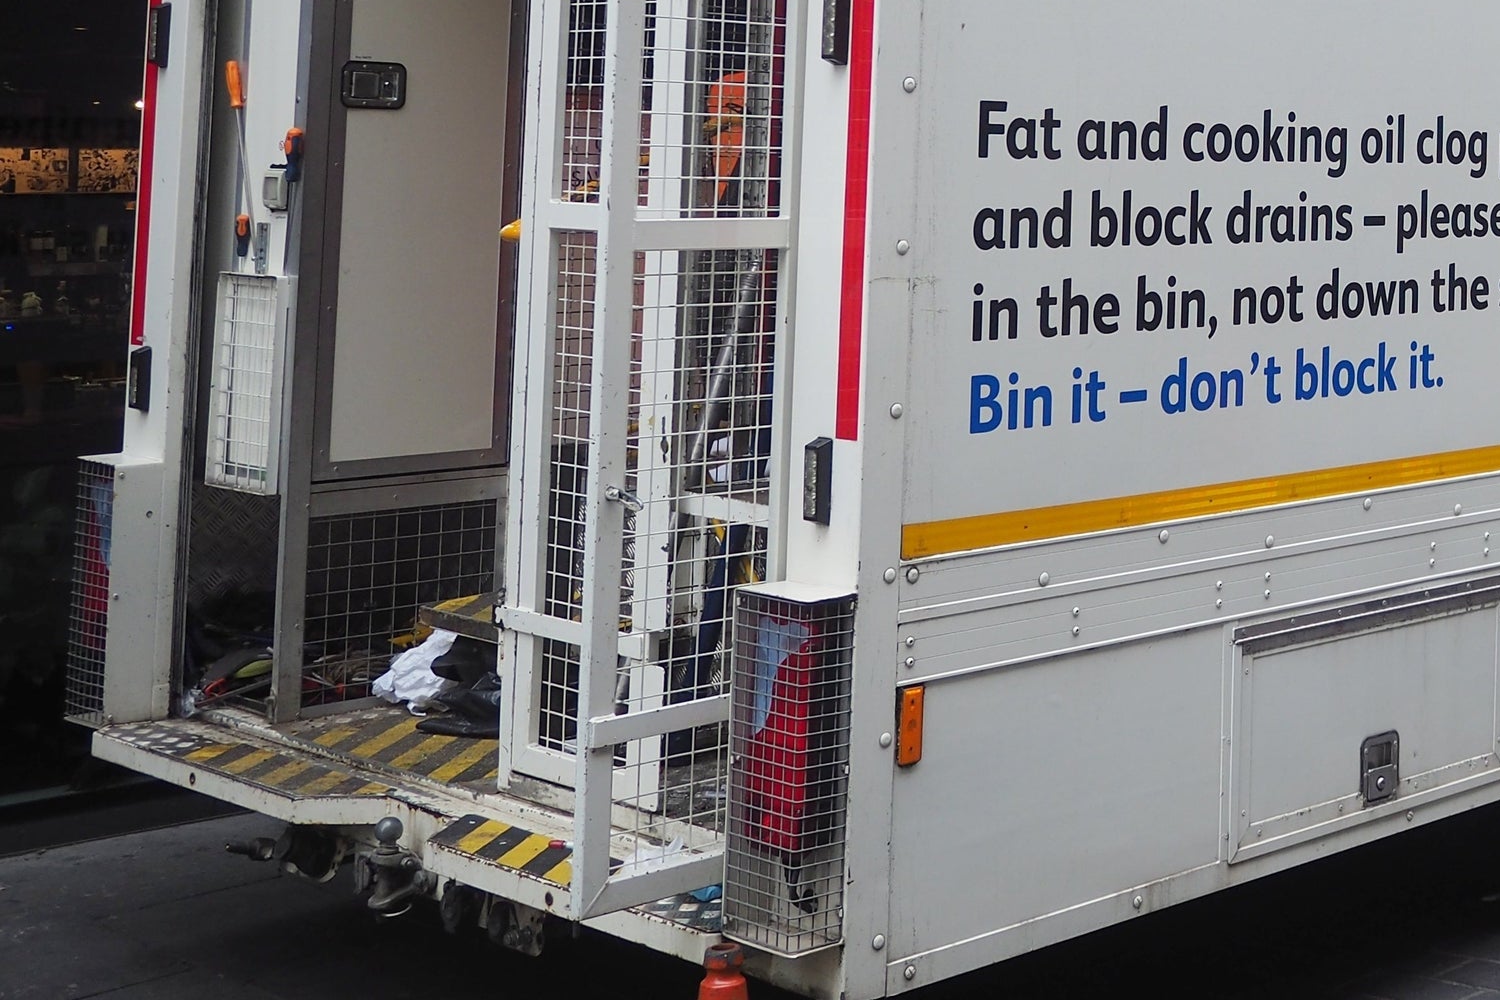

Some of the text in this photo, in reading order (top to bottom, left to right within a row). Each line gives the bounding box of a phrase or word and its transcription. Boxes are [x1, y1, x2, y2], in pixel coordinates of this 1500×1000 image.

[978, 100, 1061, 161] Fat
[1077, 105, 1168, 162] and
[1183, 109, 1348, 179] cooking
[1361, 113, 1405, 164] oil
[1416, 115, 1488, 179] clog
[972, 189, 1073, 251] and
[1090, 189, 1213, 248] block
[1225, 189, 1353, 243] drains
[971, 282, 1019, 342] in
[1036, 277, 1121, 338] the
[1135, 274, 1218, 340] bin,
[1232, 276, 1304, 326] not
[1316, 267, 1419, 321] down
[1430, 262, 1490, 313] the
[969, 374, 1053, 435] Bin
[1071, 366, 1107, 424] it
[1294, 341, 1398, 401] block
[1409, 340, 1445, 390] it.
